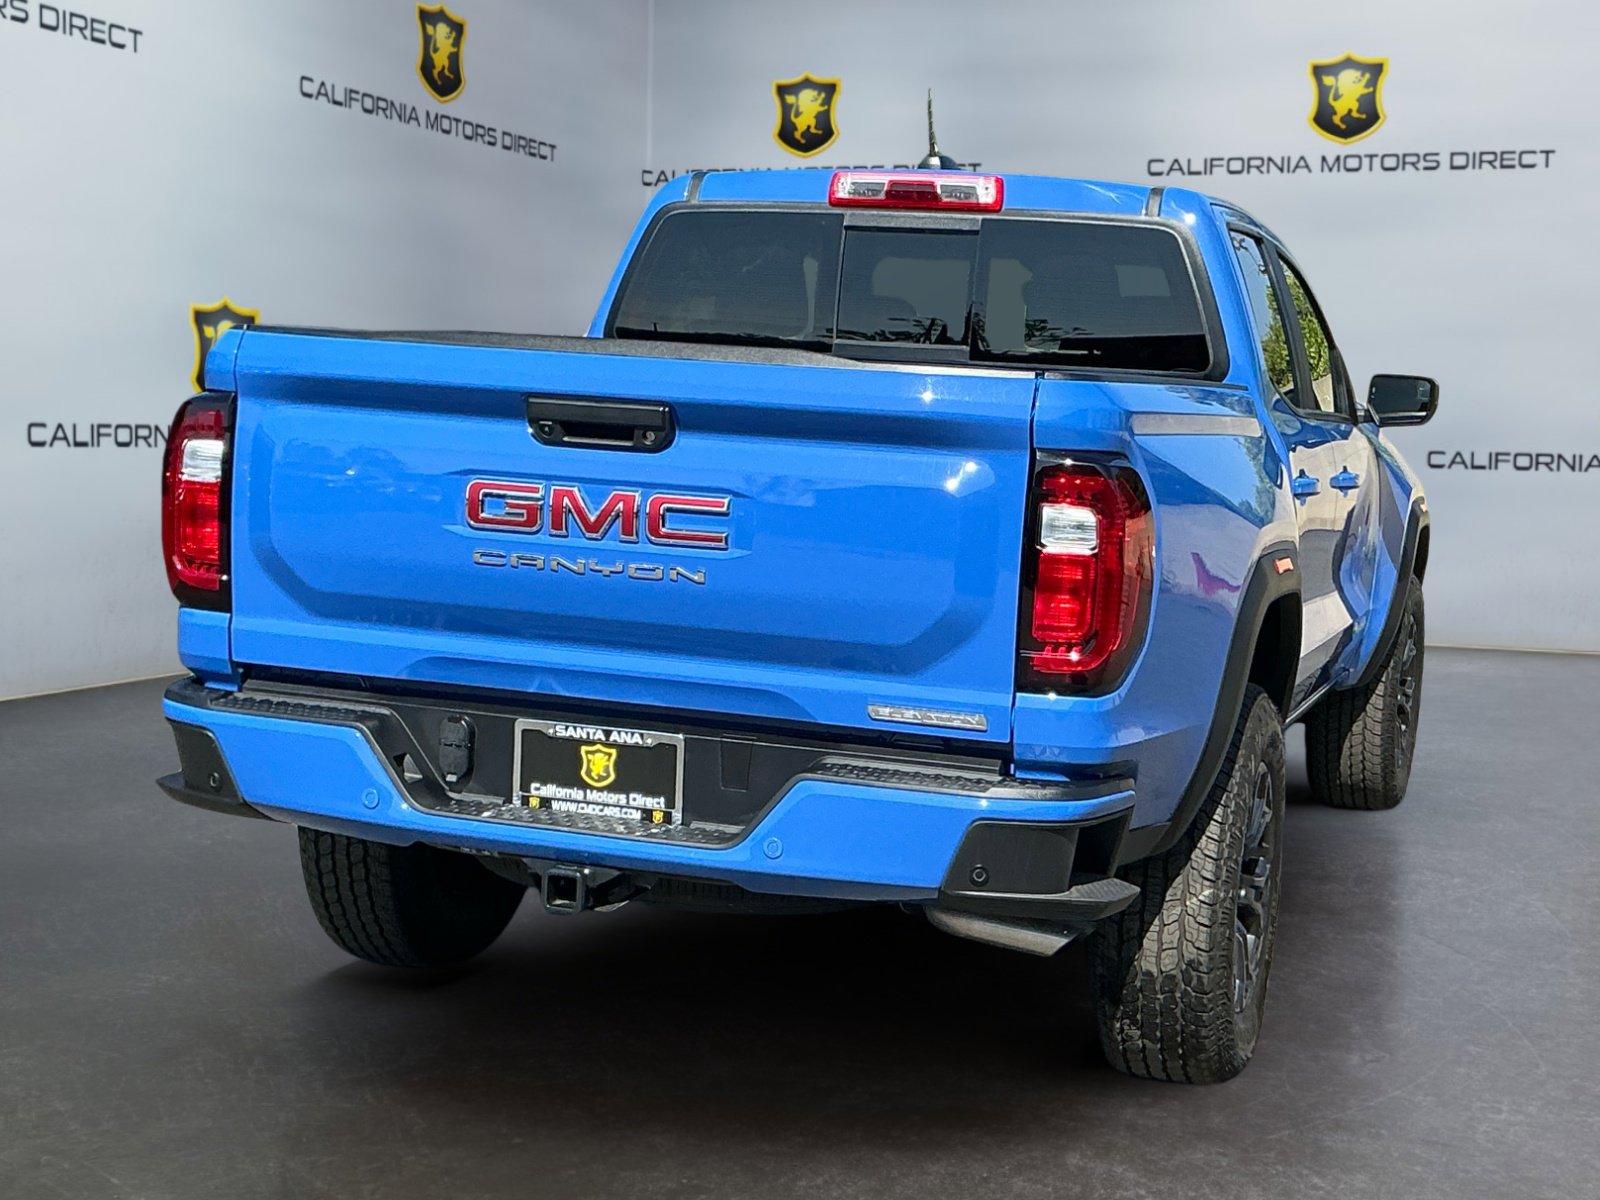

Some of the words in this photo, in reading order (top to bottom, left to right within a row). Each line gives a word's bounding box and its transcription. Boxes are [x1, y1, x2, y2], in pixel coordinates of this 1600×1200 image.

[39, 3, 143, 53] DIRECT
[299, 75, 420, 128] CALIFORNIA
[425, 110, 498, 147] MOTORS
[501, 130, 557, 162] DIRECT
[1147, 155, 1312, 177] CALIFORNIA
[1320, 152, 1441, 174] MOTORS
[1449, 149, 1557, 171] DIRECT
[1427, 450, 1600, 473] CALIFORNIA
[466, 478, 732, 551] GMC
[472, 549, 706, 584] CANYON
[555, 725, 606, 741] SANTA
[609, 731, 643, 744] ANA
[530, 782, 585, 799] California
[586, 788, 627, 805] Motors
[629, 793, 665, 809] Direct
